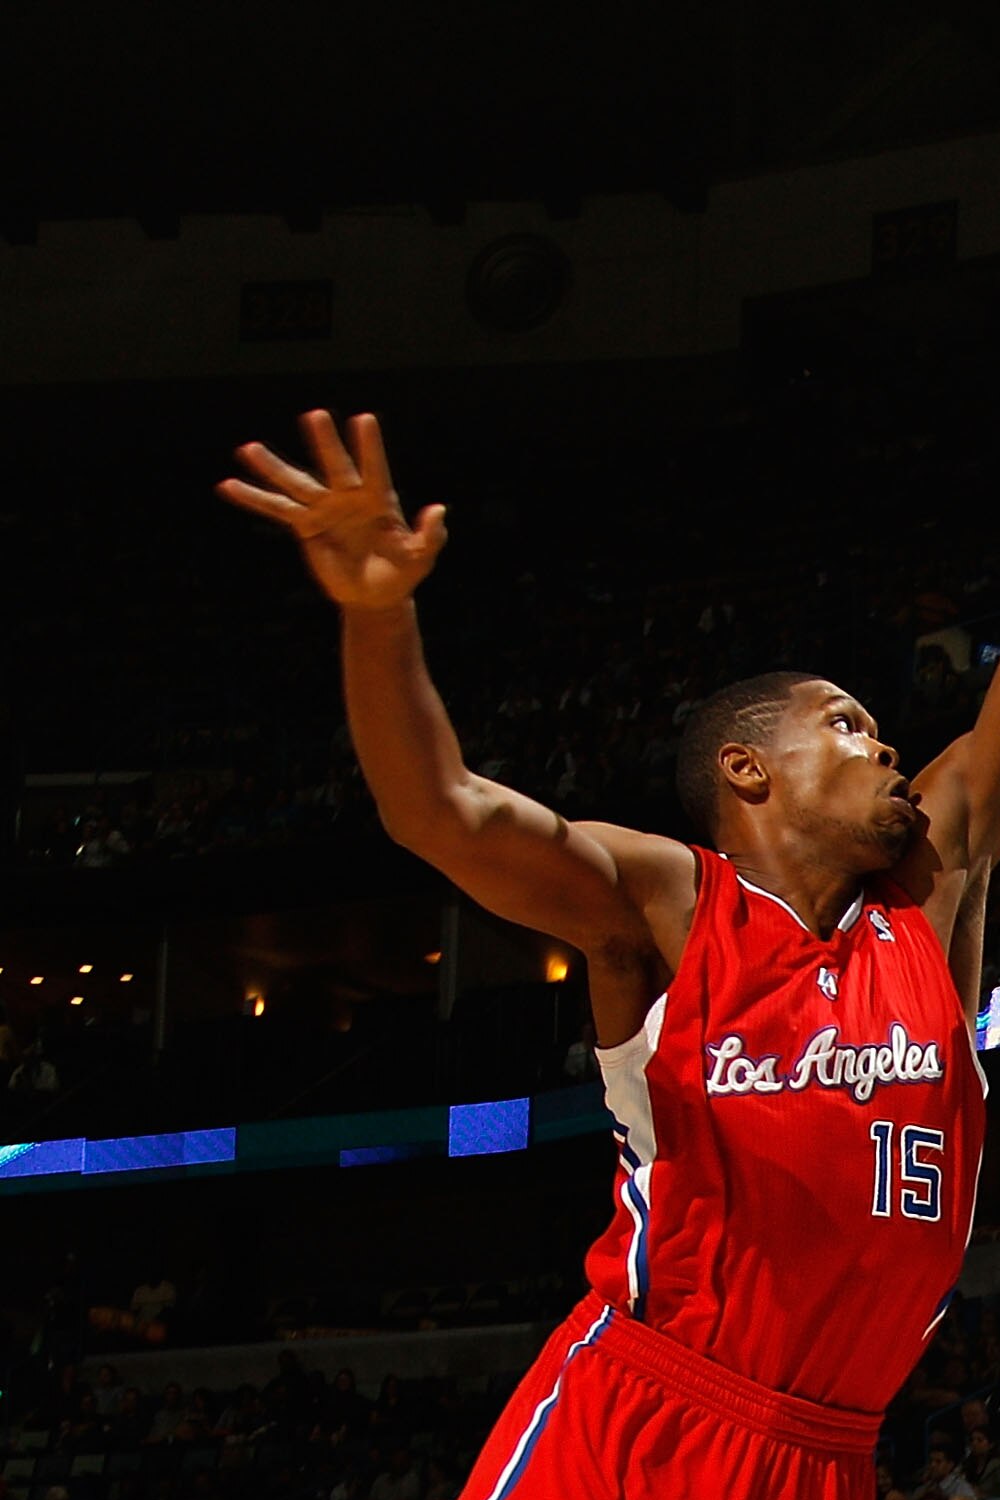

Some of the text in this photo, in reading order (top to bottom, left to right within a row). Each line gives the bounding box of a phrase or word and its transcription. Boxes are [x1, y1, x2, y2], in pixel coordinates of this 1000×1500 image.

[706, 1021, 944, 1105] Los Angeles
[870, 1120, 944, 1222] 15
